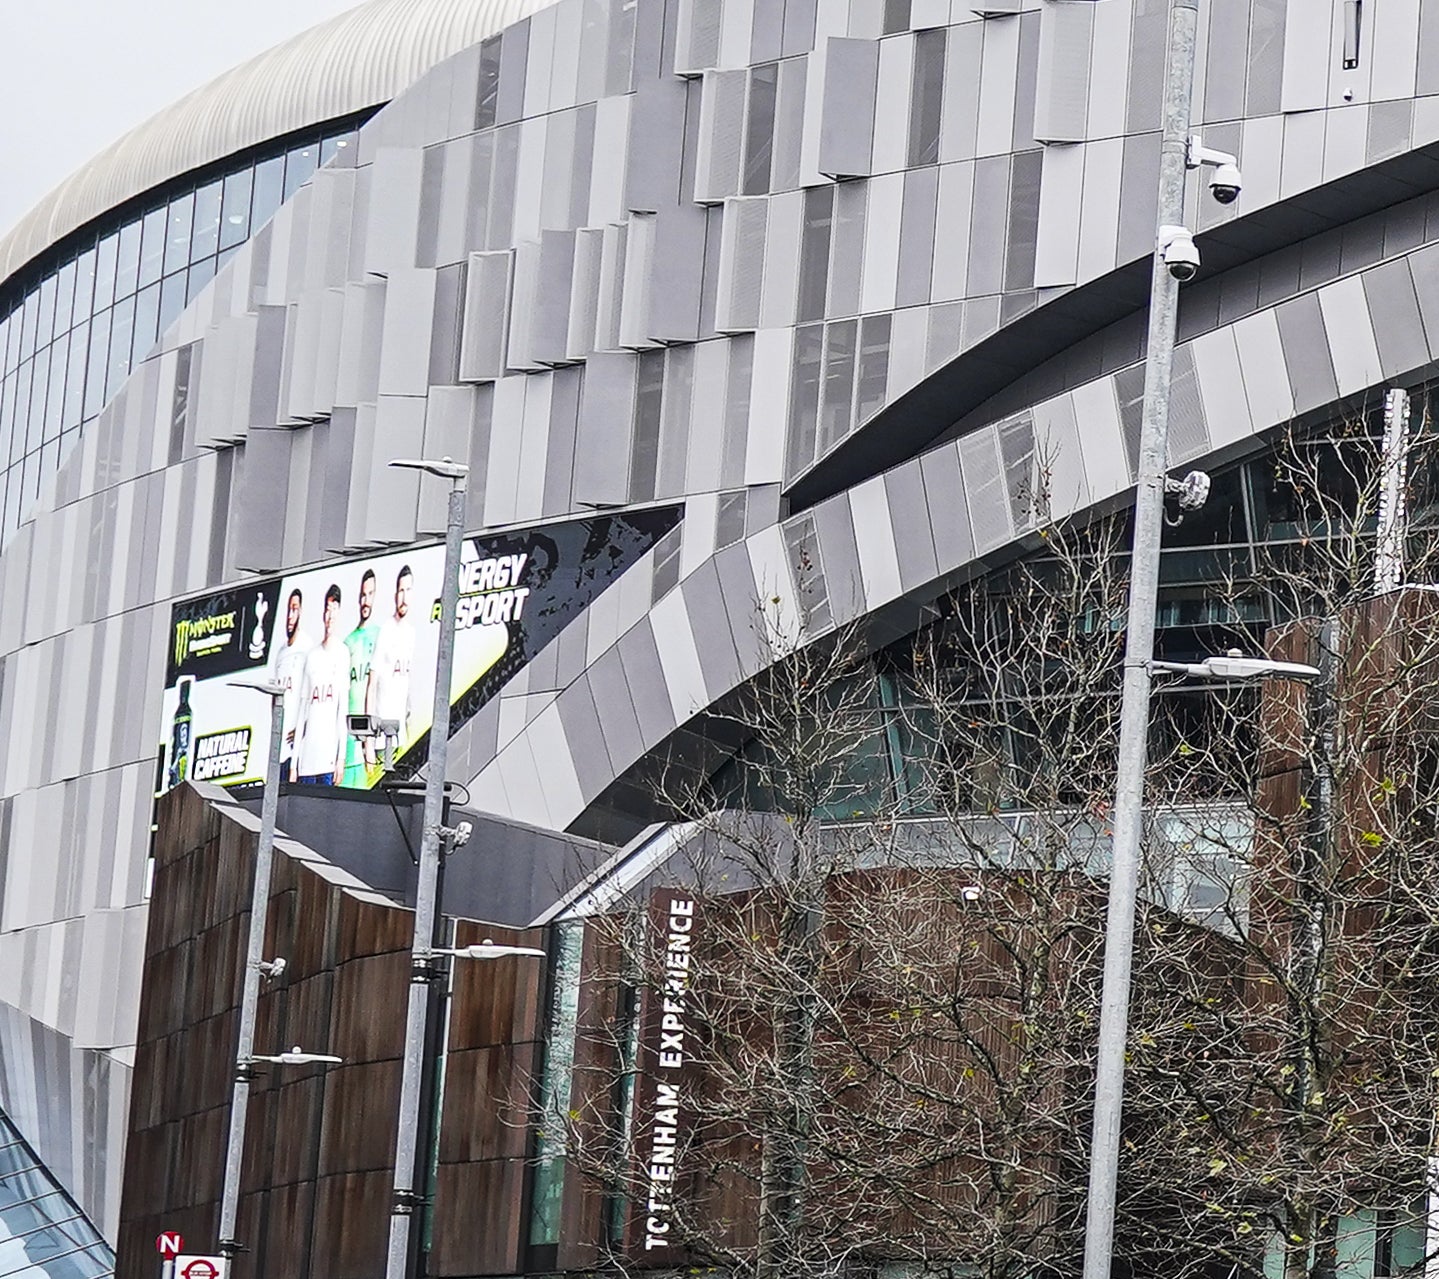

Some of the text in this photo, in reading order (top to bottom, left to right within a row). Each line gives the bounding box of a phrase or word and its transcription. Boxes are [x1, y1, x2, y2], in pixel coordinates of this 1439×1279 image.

[458, 553, 528, 595] NERGY
[454, 588, 530, 631] SPORT
[310, 683, 334, 705] AIA
[197, 730, 250, 760] NATURAL
[193, 751, 249, 782] CAFFEINE
[160, 1235, 180, 1253] N
